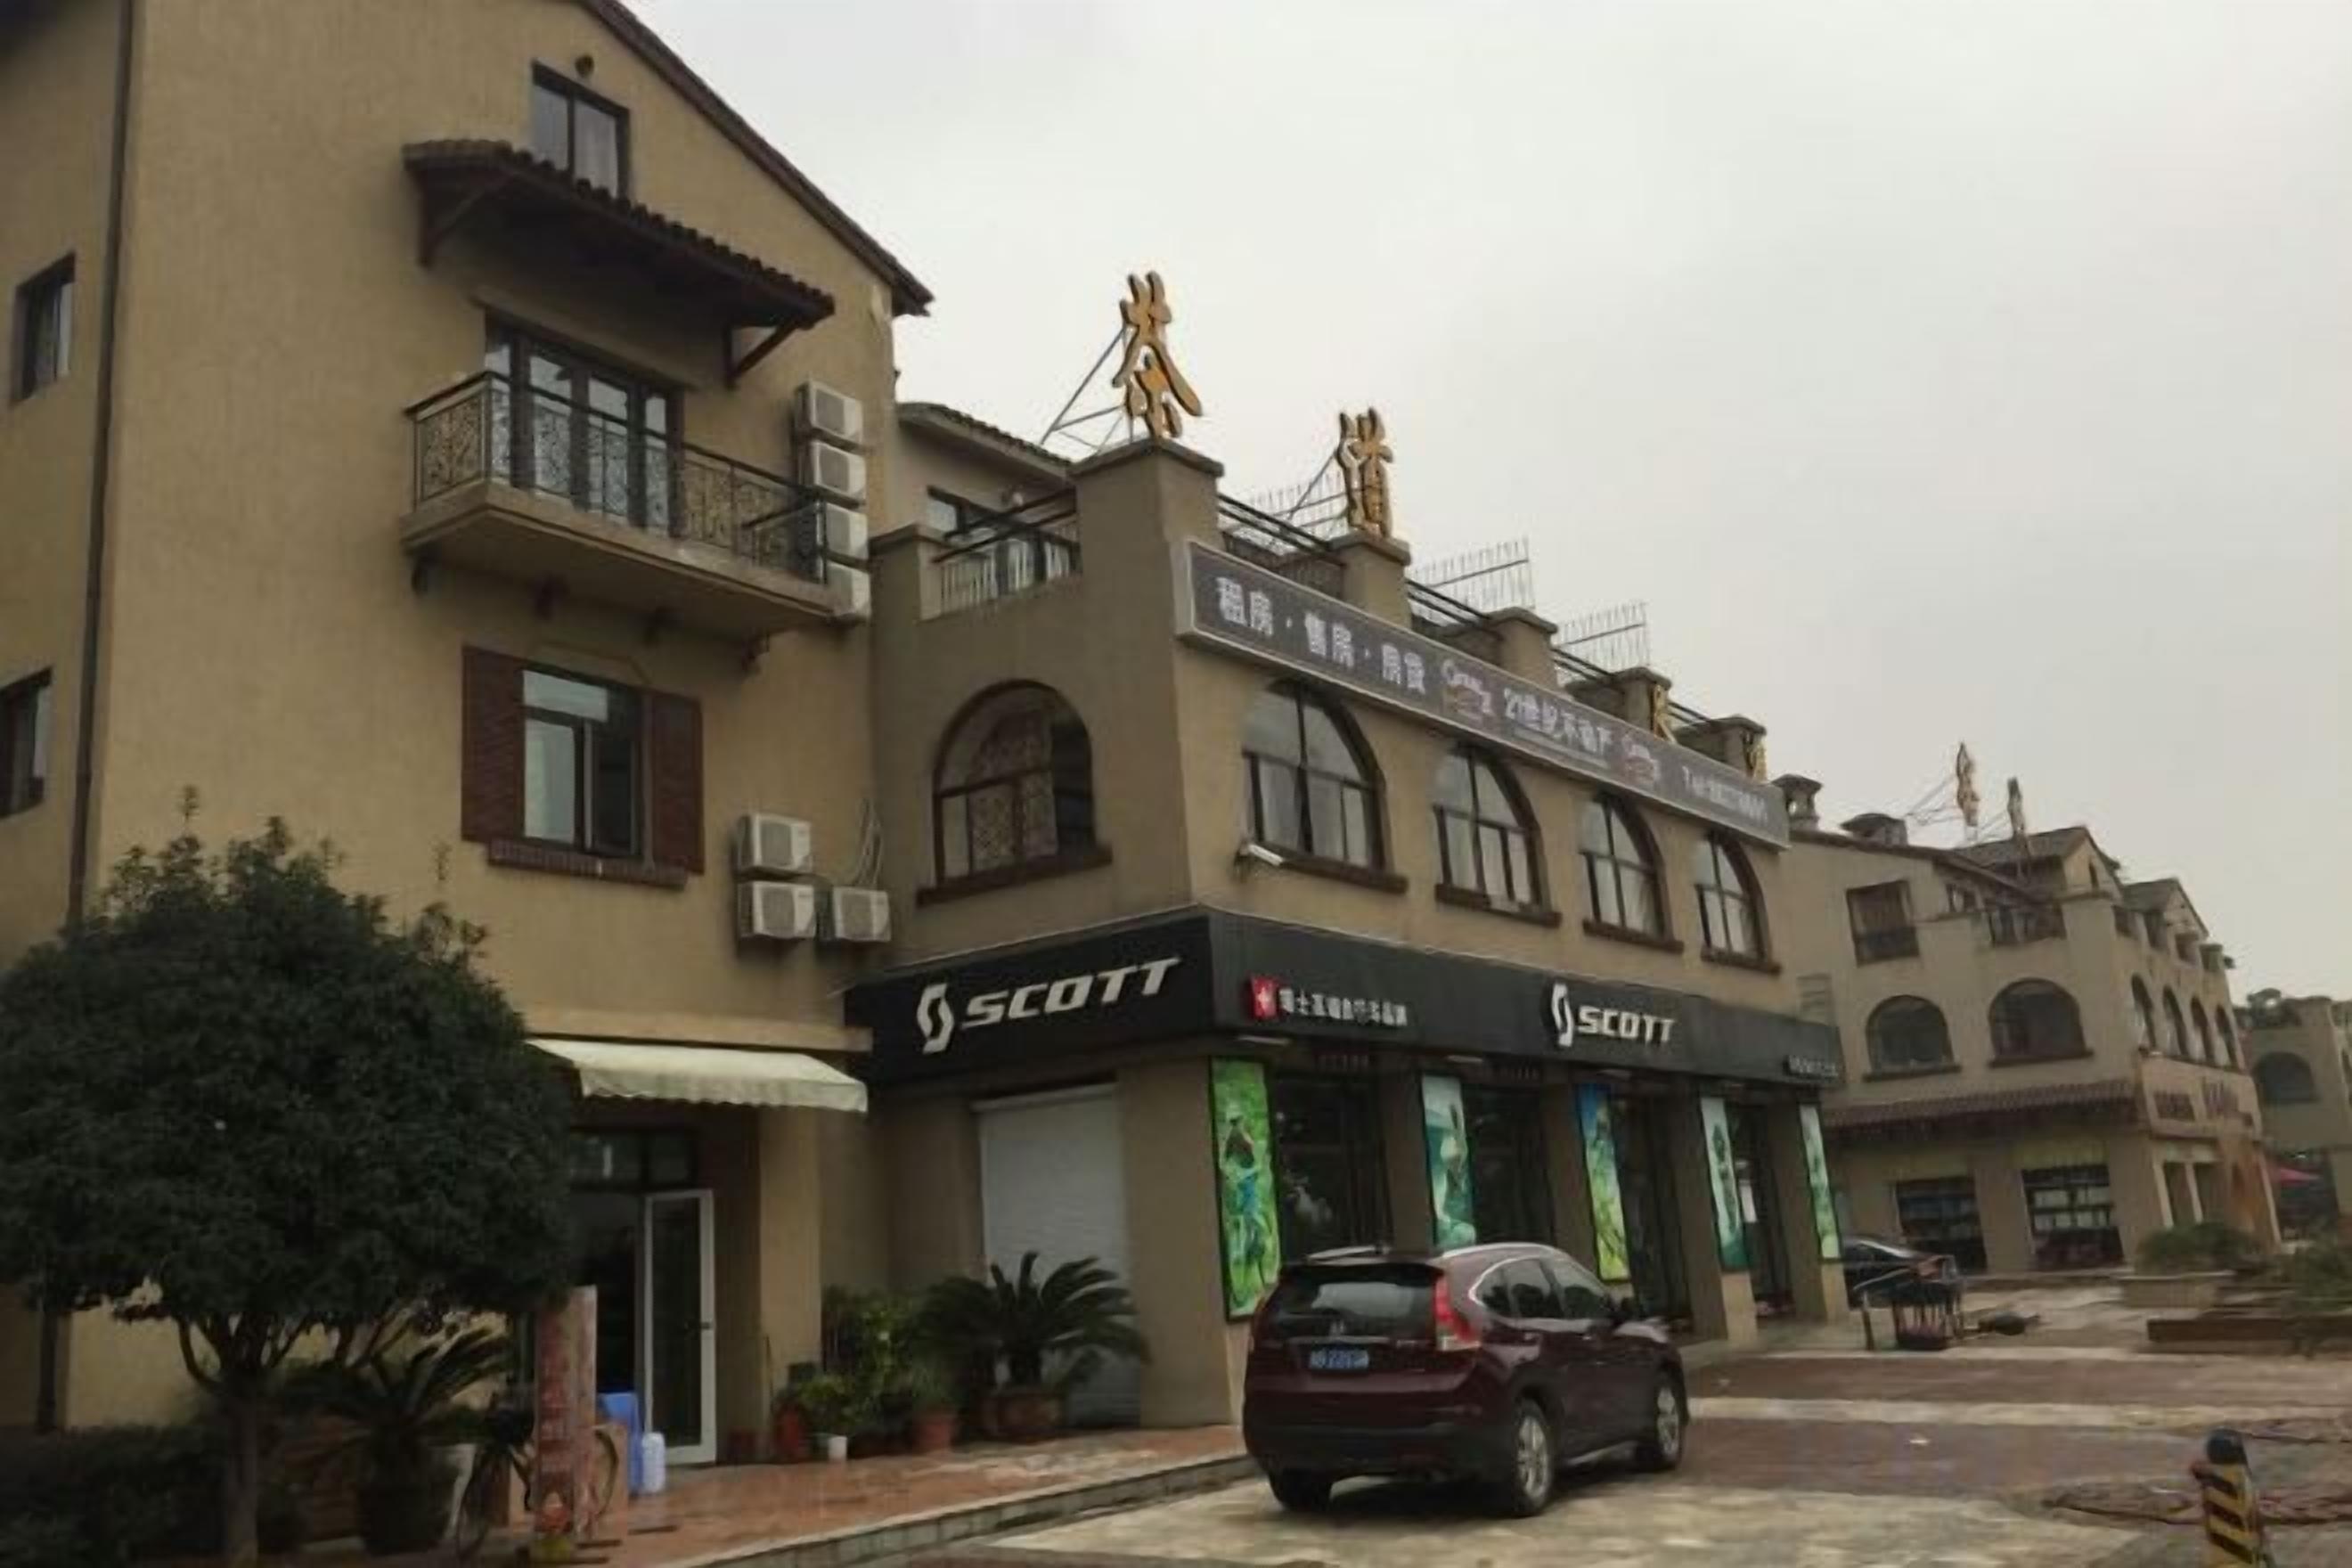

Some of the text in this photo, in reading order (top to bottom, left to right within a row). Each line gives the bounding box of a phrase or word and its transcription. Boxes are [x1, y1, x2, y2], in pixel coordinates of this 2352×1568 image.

[1111, 271, 1203, 438] 茶
[960, 957, 1182, 1031] SCOTT
[1577, 1004, 1676, 1042] SCOTT
